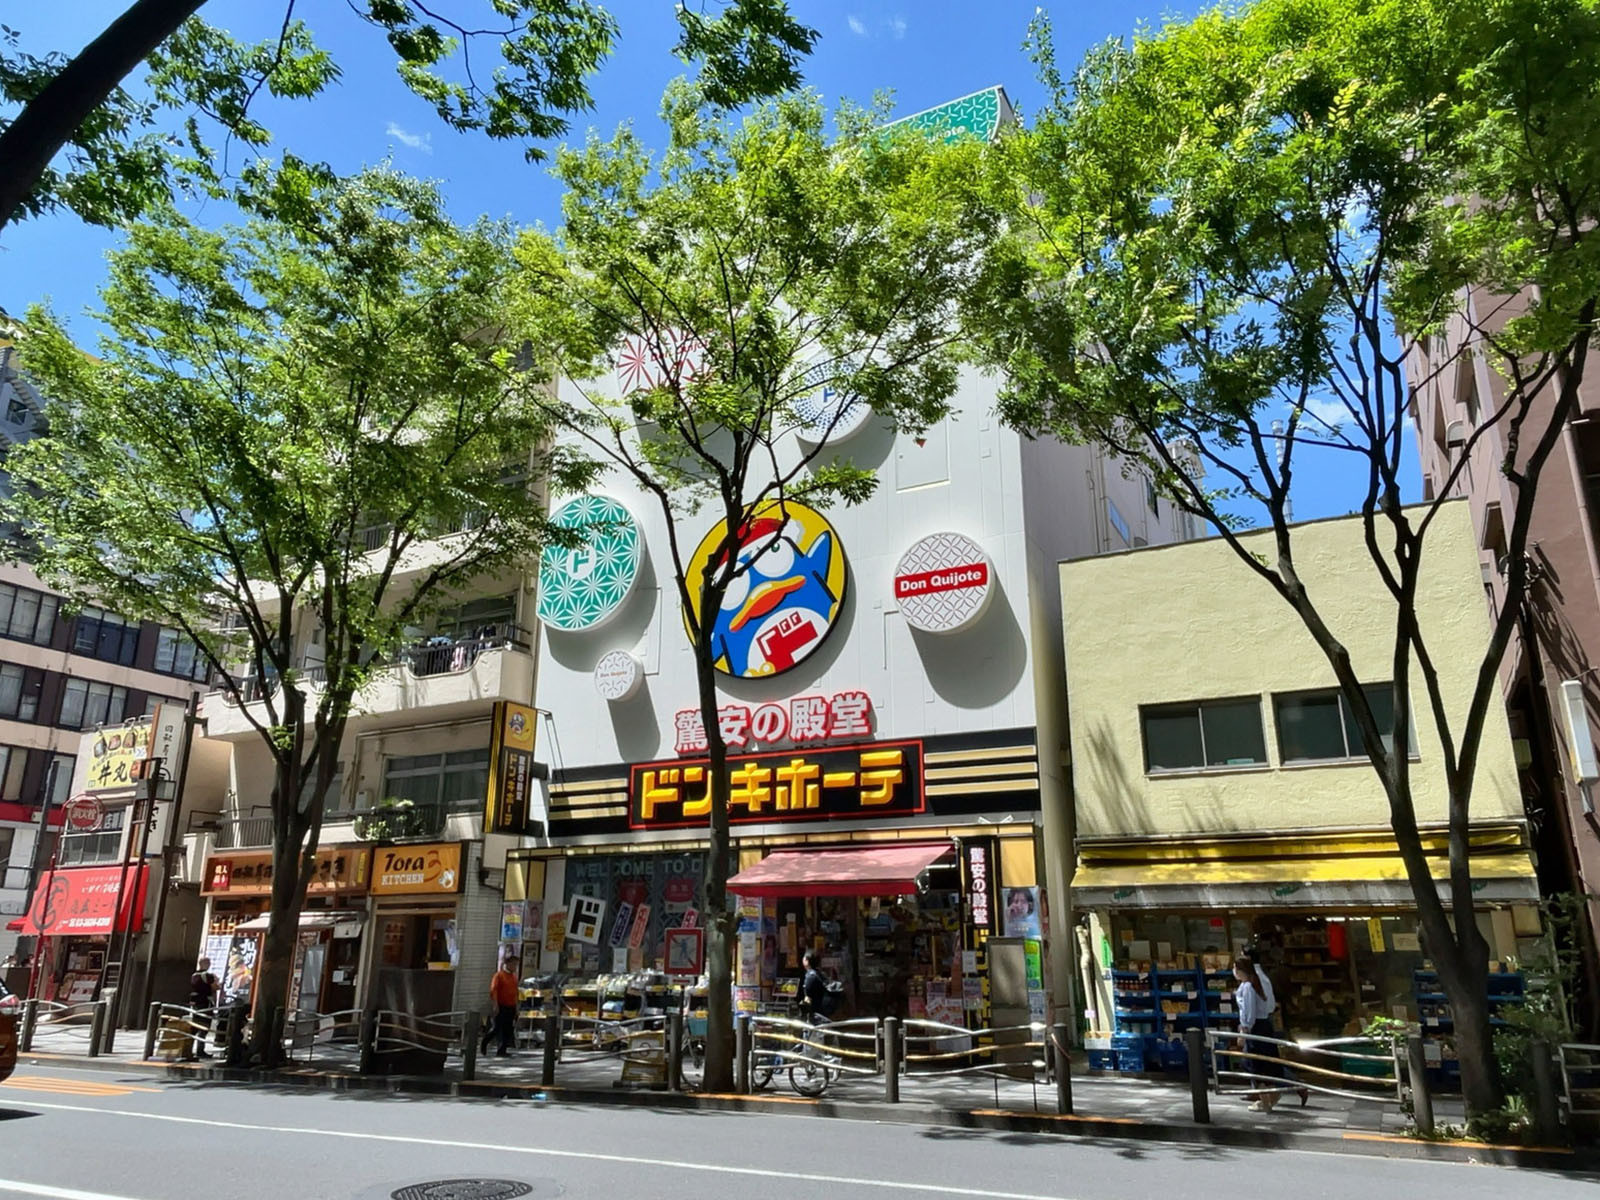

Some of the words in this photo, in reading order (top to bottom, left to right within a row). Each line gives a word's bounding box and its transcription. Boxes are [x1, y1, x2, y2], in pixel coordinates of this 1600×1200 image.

[900, 579, 927, 592] Don
[930, 570, 982, 587] Quijote
[756, 611, 818, 673] ド
[674, 692, 872, 755] 驚安の殿堂
[641, 750, 903, 819] ドンキホーテ
[381, 873, 424, 885] KITCHEN
[384, 853, 424, 872] Tora
[970, 847, 988, 924] 驚安の殿堂
